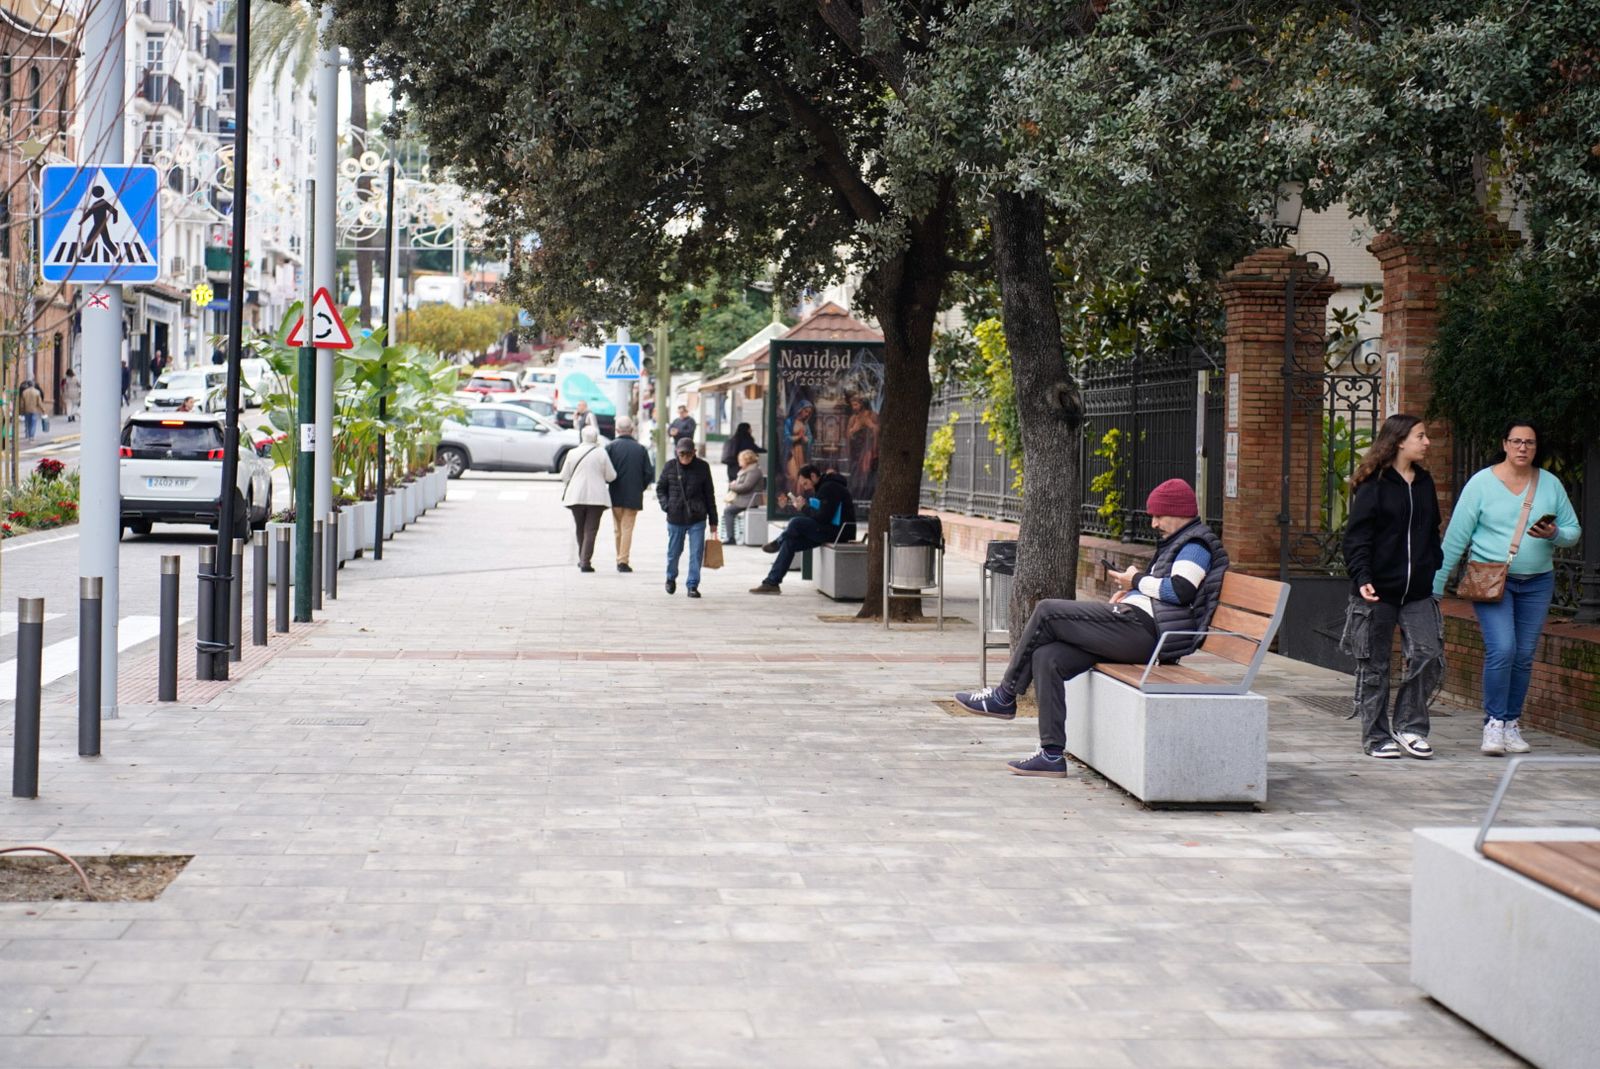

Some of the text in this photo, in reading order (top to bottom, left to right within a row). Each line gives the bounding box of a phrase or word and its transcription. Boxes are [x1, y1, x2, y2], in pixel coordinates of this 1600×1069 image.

[780, 349, 851, 369] Navidad
[782, 366, 841, 385] especial
[799, 377, 829, 386] 2025
